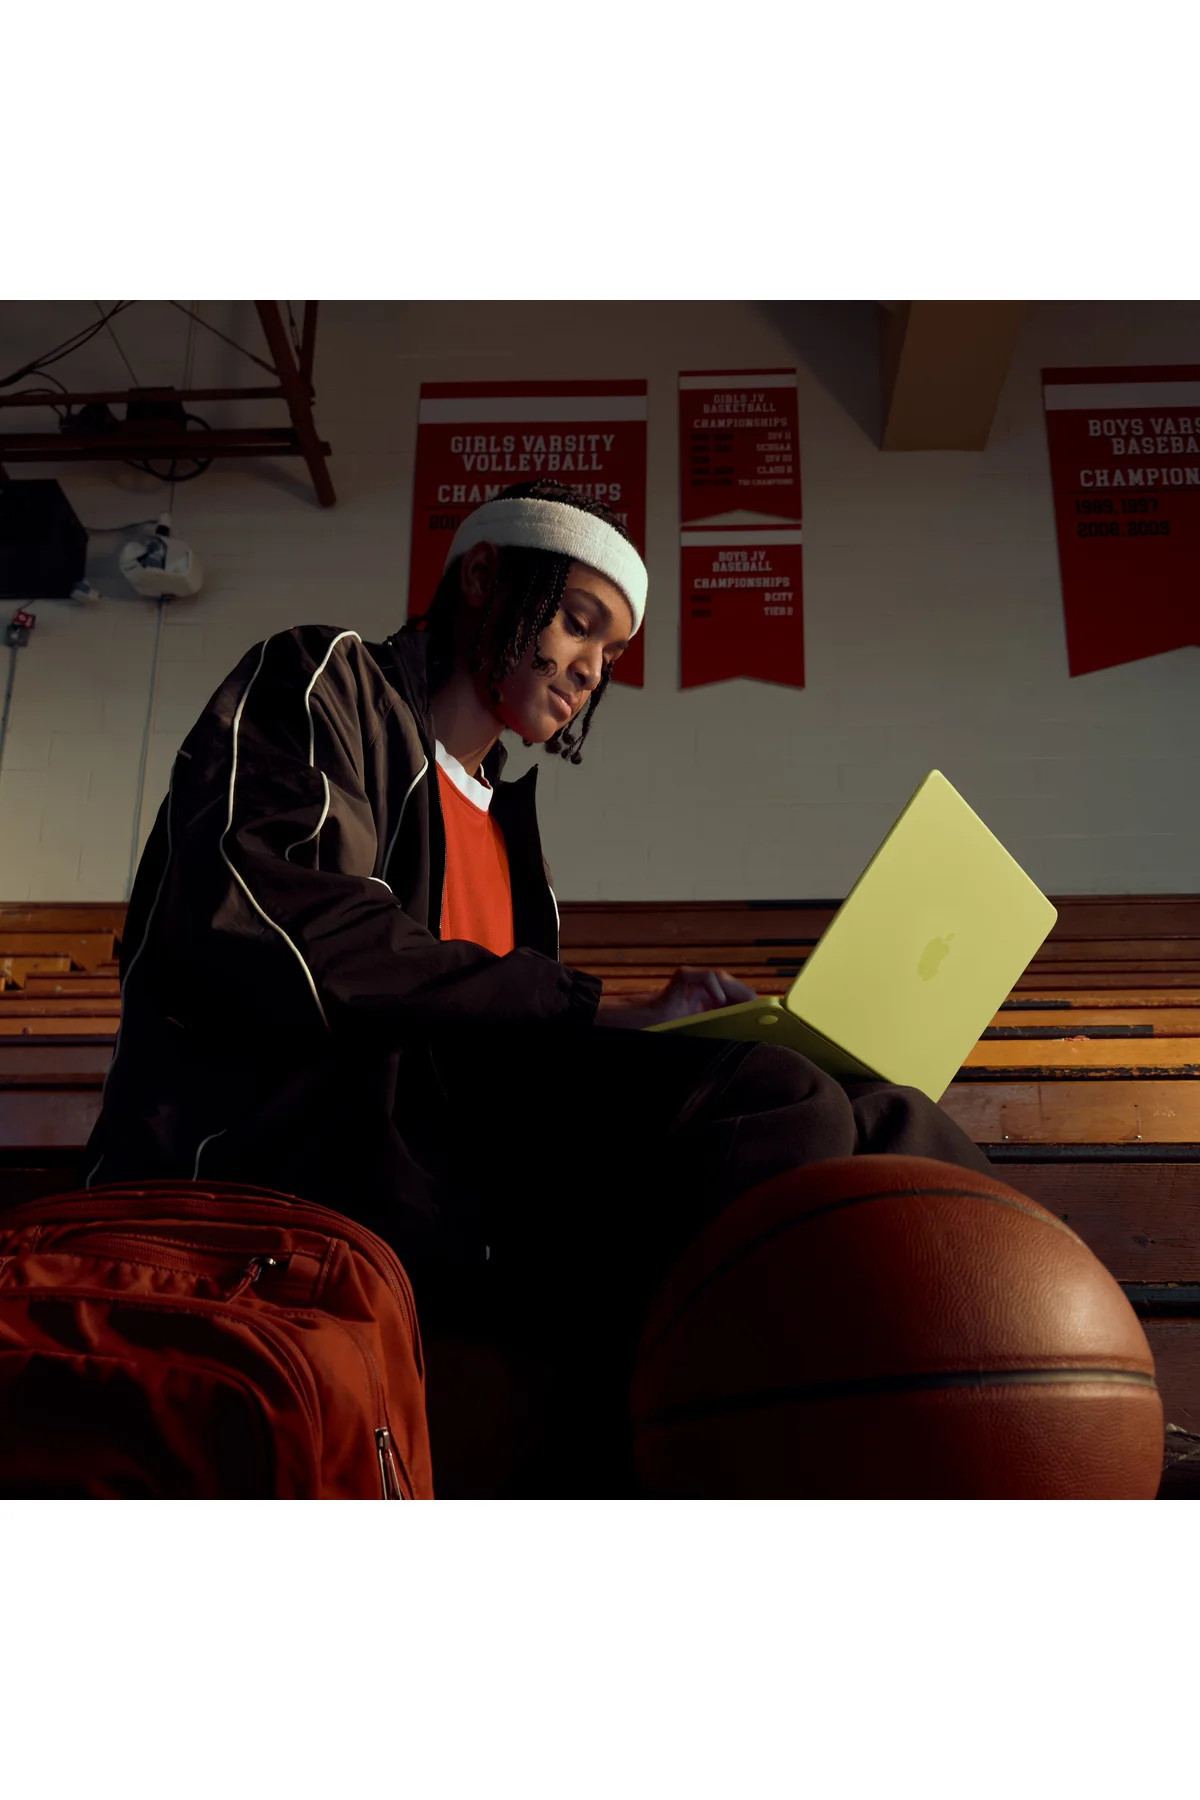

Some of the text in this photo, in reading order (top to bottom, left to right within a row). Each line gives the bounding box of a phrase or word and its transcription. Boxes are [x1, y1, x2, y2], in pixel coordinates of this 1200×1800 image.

[713, 392, 765, 404] GIRLS JV
[703, 402, 777, 414] BASKETBALL
[693, 417, 789, 428] CHAMPIONSHIPS
[1087, 418, 1144, 437] BOYS
[450, 433, 616, 453] GIRLS VARSITY
[1111, 435, 1200, 455] BASEBA
[462, 453, 603, 472] VOLLEYBALL
[1079, 467, 1200, 488] CHAMPION
[437, 482, 622, 503] CHAMHIPS
[1120, 496, 1158, 514] 1997
[1127, 519, 1170, 537] 2009
[719, 550, 766, 562] BOYS JV
[712, 561, 773, 572] BASEBALL
[694, 576, 790, 589] CHAMPIONSHIPS
